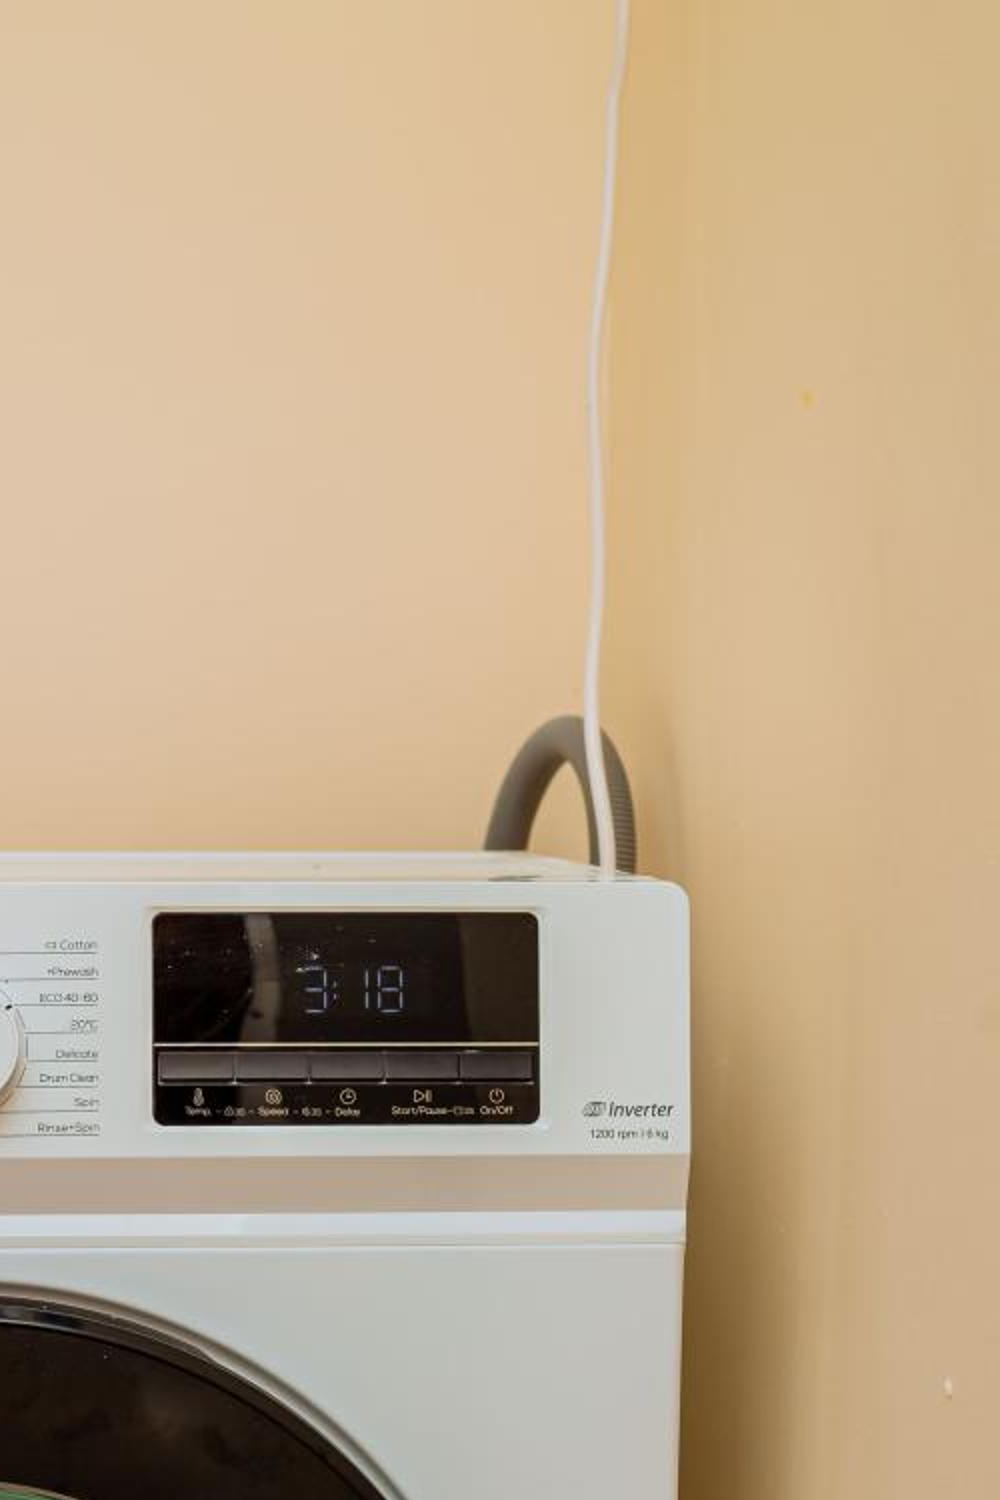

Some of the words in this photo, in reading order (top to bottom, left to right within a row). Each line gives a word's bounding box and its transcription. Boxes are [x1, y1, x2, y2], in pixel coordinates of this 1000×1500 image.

[59, 939, 98, 950] Cotton
[40, 1073, 68, 1083] Drum
[480, 1105, 513, 1116] On/Off
[591, 1129, 614, 1139] 1200
[617, 1130, 638, 1140] rpm
